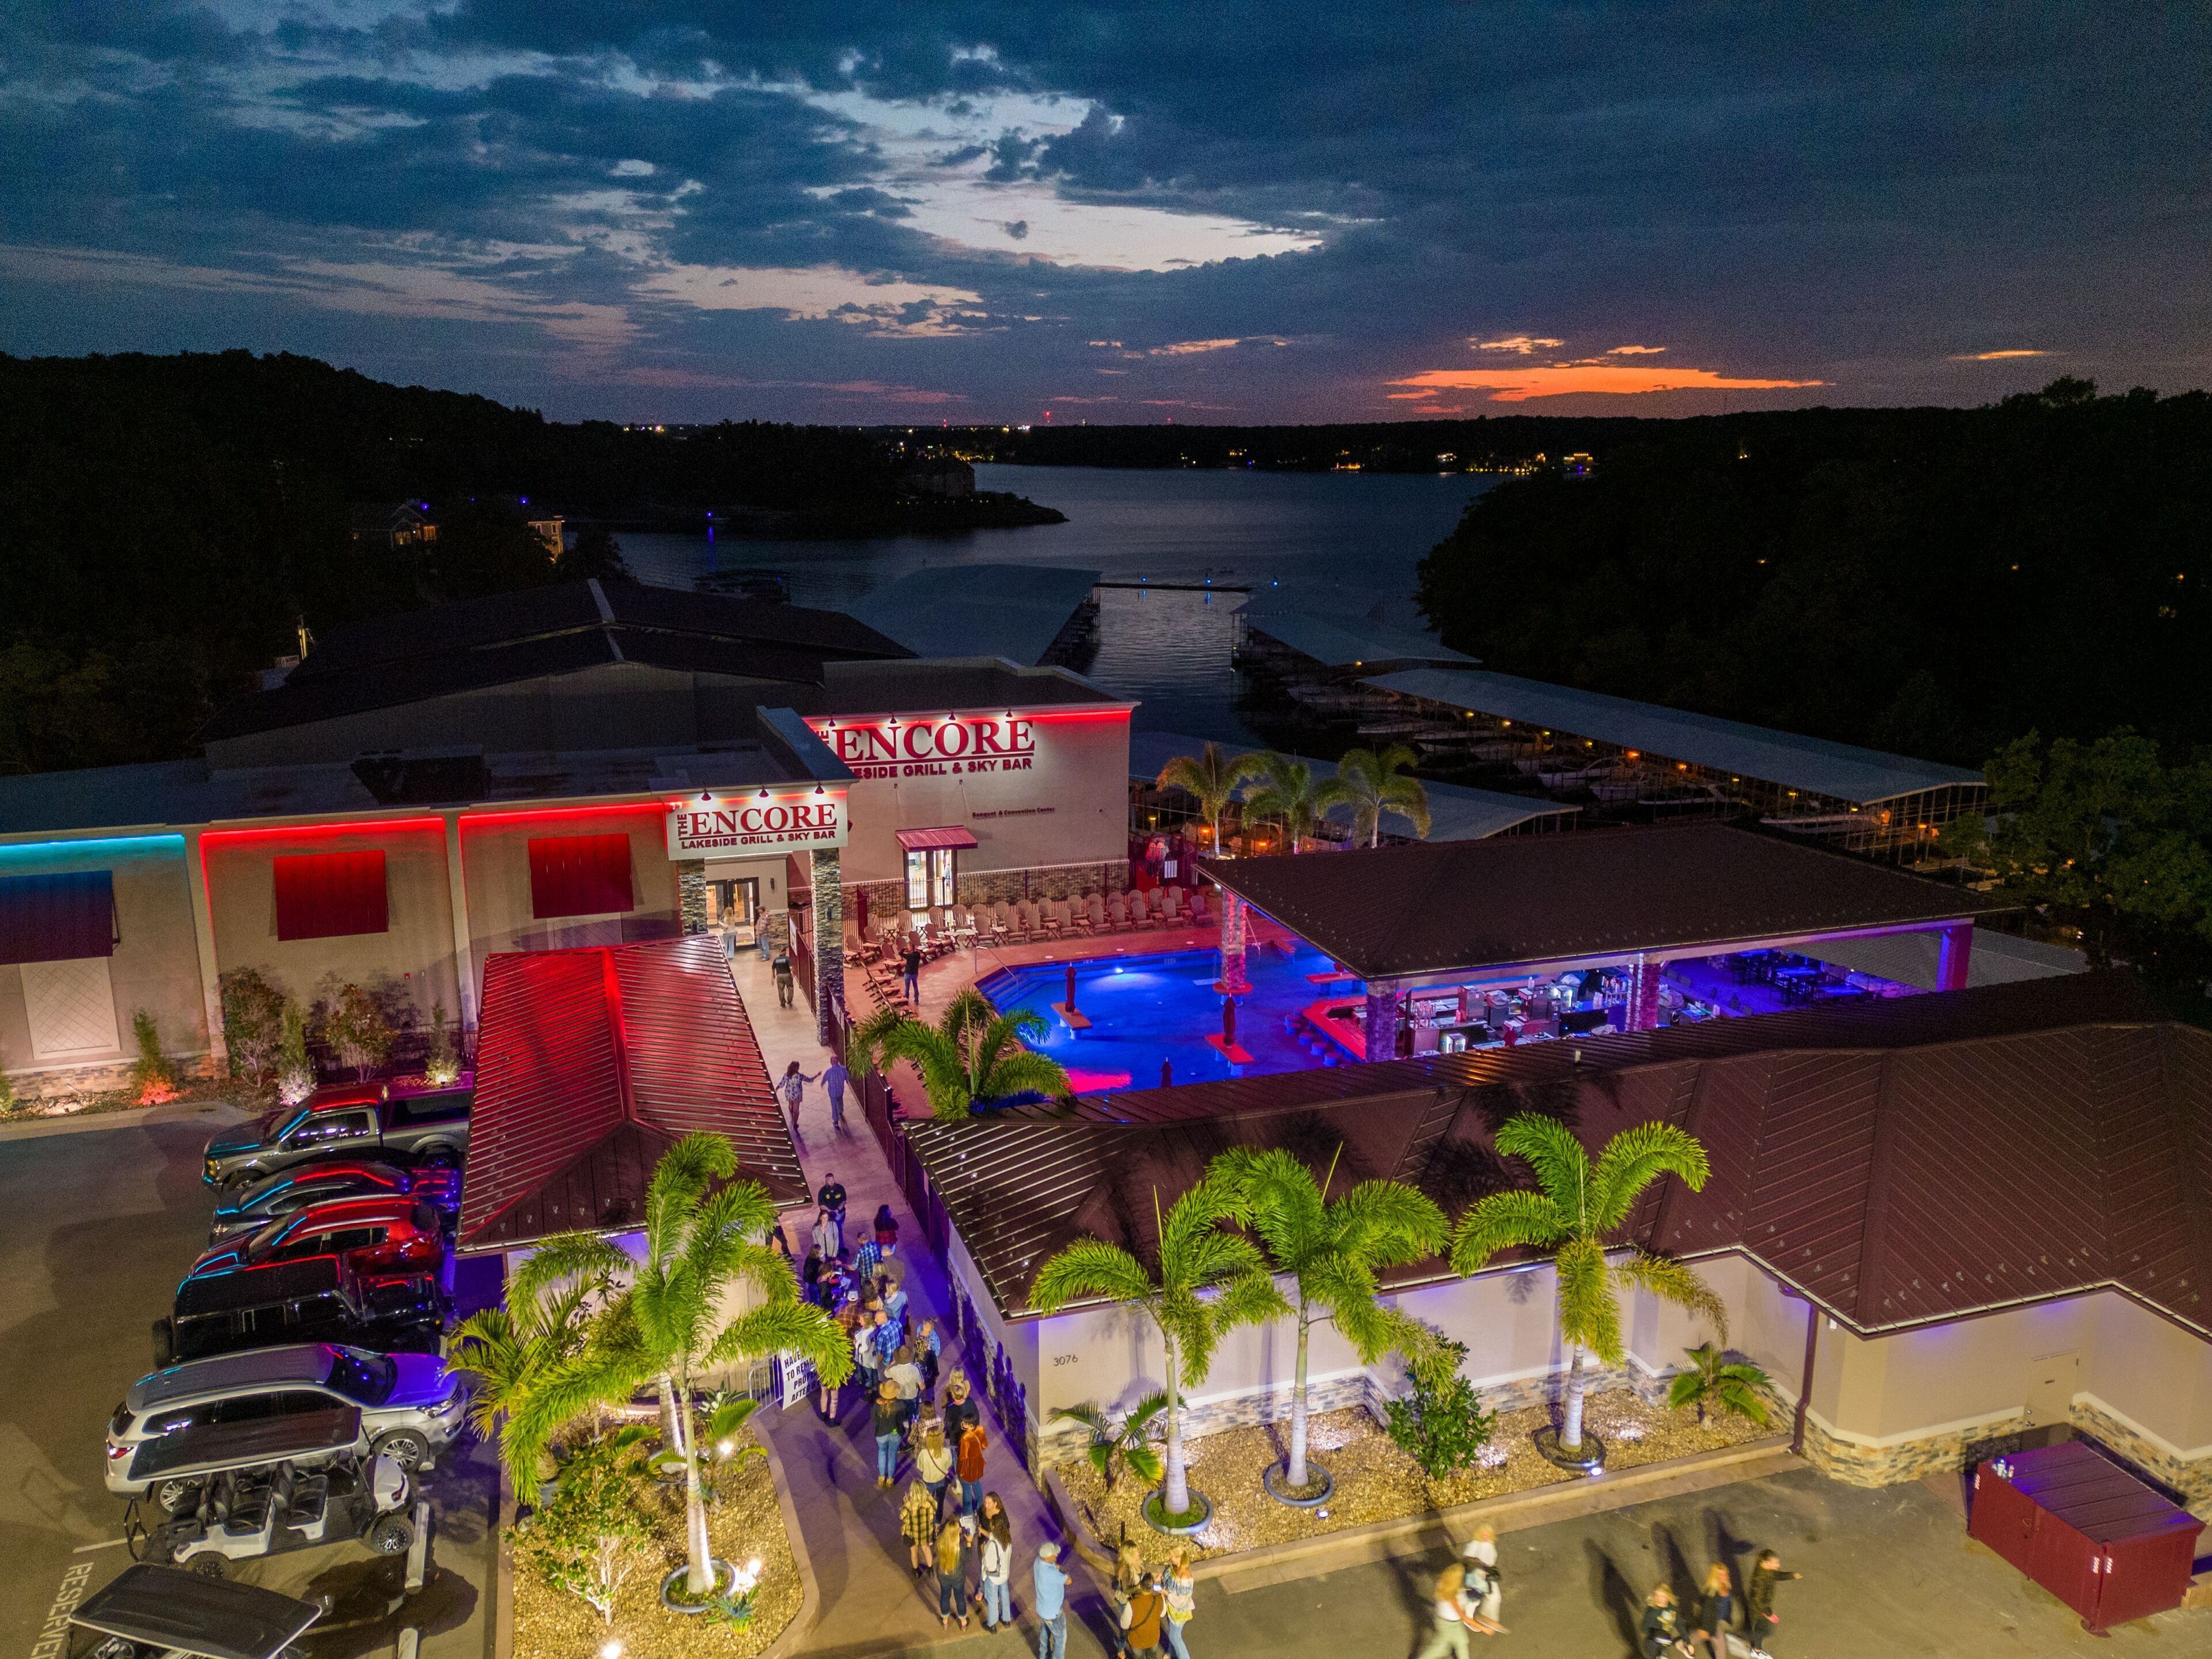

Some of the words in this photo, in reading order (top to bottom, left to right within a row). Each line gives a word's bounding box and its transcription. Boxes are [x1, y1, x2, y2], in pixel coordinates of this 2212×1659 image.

[832, 720, 1036, 761] ENCORE
[851, 766, 898, 779] ESIDE
[903, 763, 947, 777] GRILL
[952, 762, 963, 774] &
[968, 760, 998, 771] SKY
[1002, 757, 1032, 770] BAR
[677, 814, 688, 836] THE
[688, 804, 838, 836] ENCORE
[681, 837, 737, 850] LAKESIDE
[741, 835, 773, 844] GRILL
[777, 834, 785, 842] &
[788, 832, 809, 842] SKY
[813, 830, 836, 839] BAR
[1053, 1354, 1078, 1367] 3076
[786, 1369, 795, 1381] TO
[791, 1384, 810, 1403] AFTER
